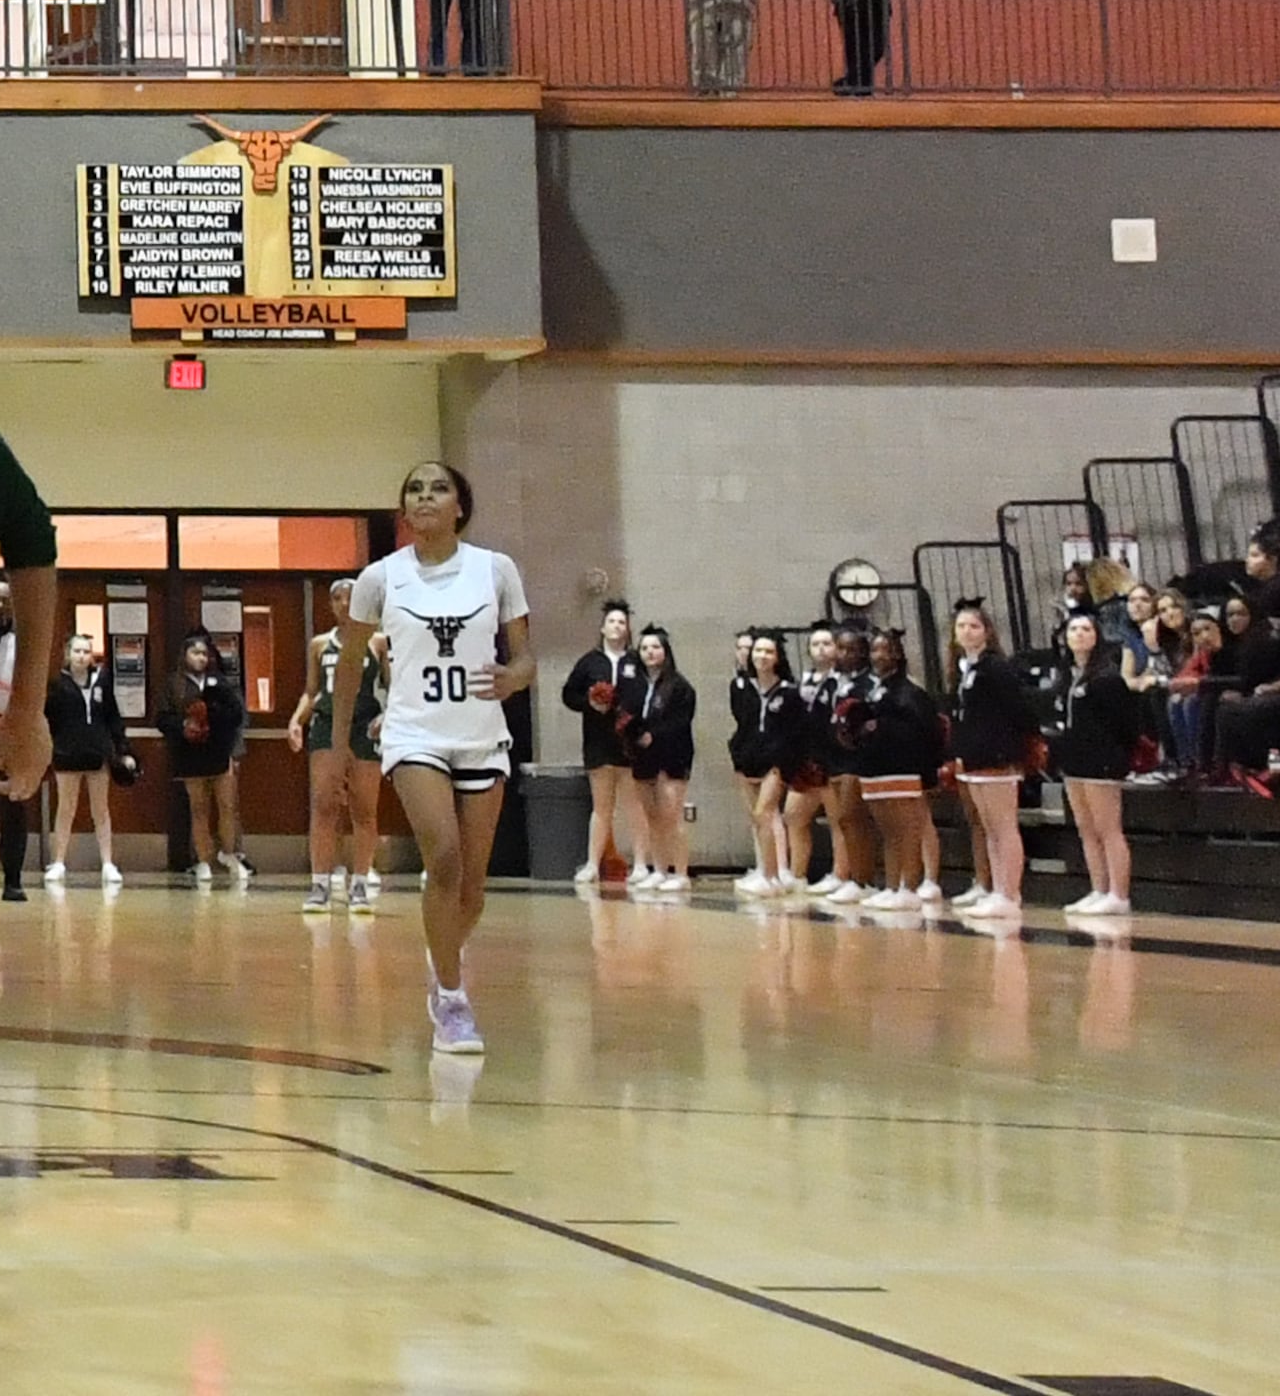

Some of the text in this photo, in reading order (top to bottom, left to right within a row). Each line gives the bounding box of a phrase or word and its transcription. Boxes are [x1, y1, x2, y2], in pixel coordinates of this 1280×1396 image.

[120, 166, 240, 178] TAYLOR SIMMONS
[329, 169, 432, 181] NICOLE LYNCH
[120, 182, 240, 194] EVIE BUFFINGTON
[321, 184, 371, 196] VANESSA
[120, 200, 241, 213] GRETCHEN MABREY
[320, 202, 442, 213] CHELSEA HOLMES
[132, 216, 228, 227] KARA REPACI
[326, 216, 436, 229] MARY BABCOCK
[120, 233, 242, 244] MADELINE GILMARTIN
[342, 233, 422, 245] ALY BISHOP
[129, 249, 233, 262] JAIDYN BROWN
[334, 251, 431, 262] REESA WELLS
[124, 266, 241, 278] SYDNEY FLEMING
[323, 266, 444, 278] ASHLEY HANSELL
[135, 281, 229, 293] RILEY MILNER
[181, 304, 356, 323] VOLLEYBALL
[423, 666, 467, 702] 30
